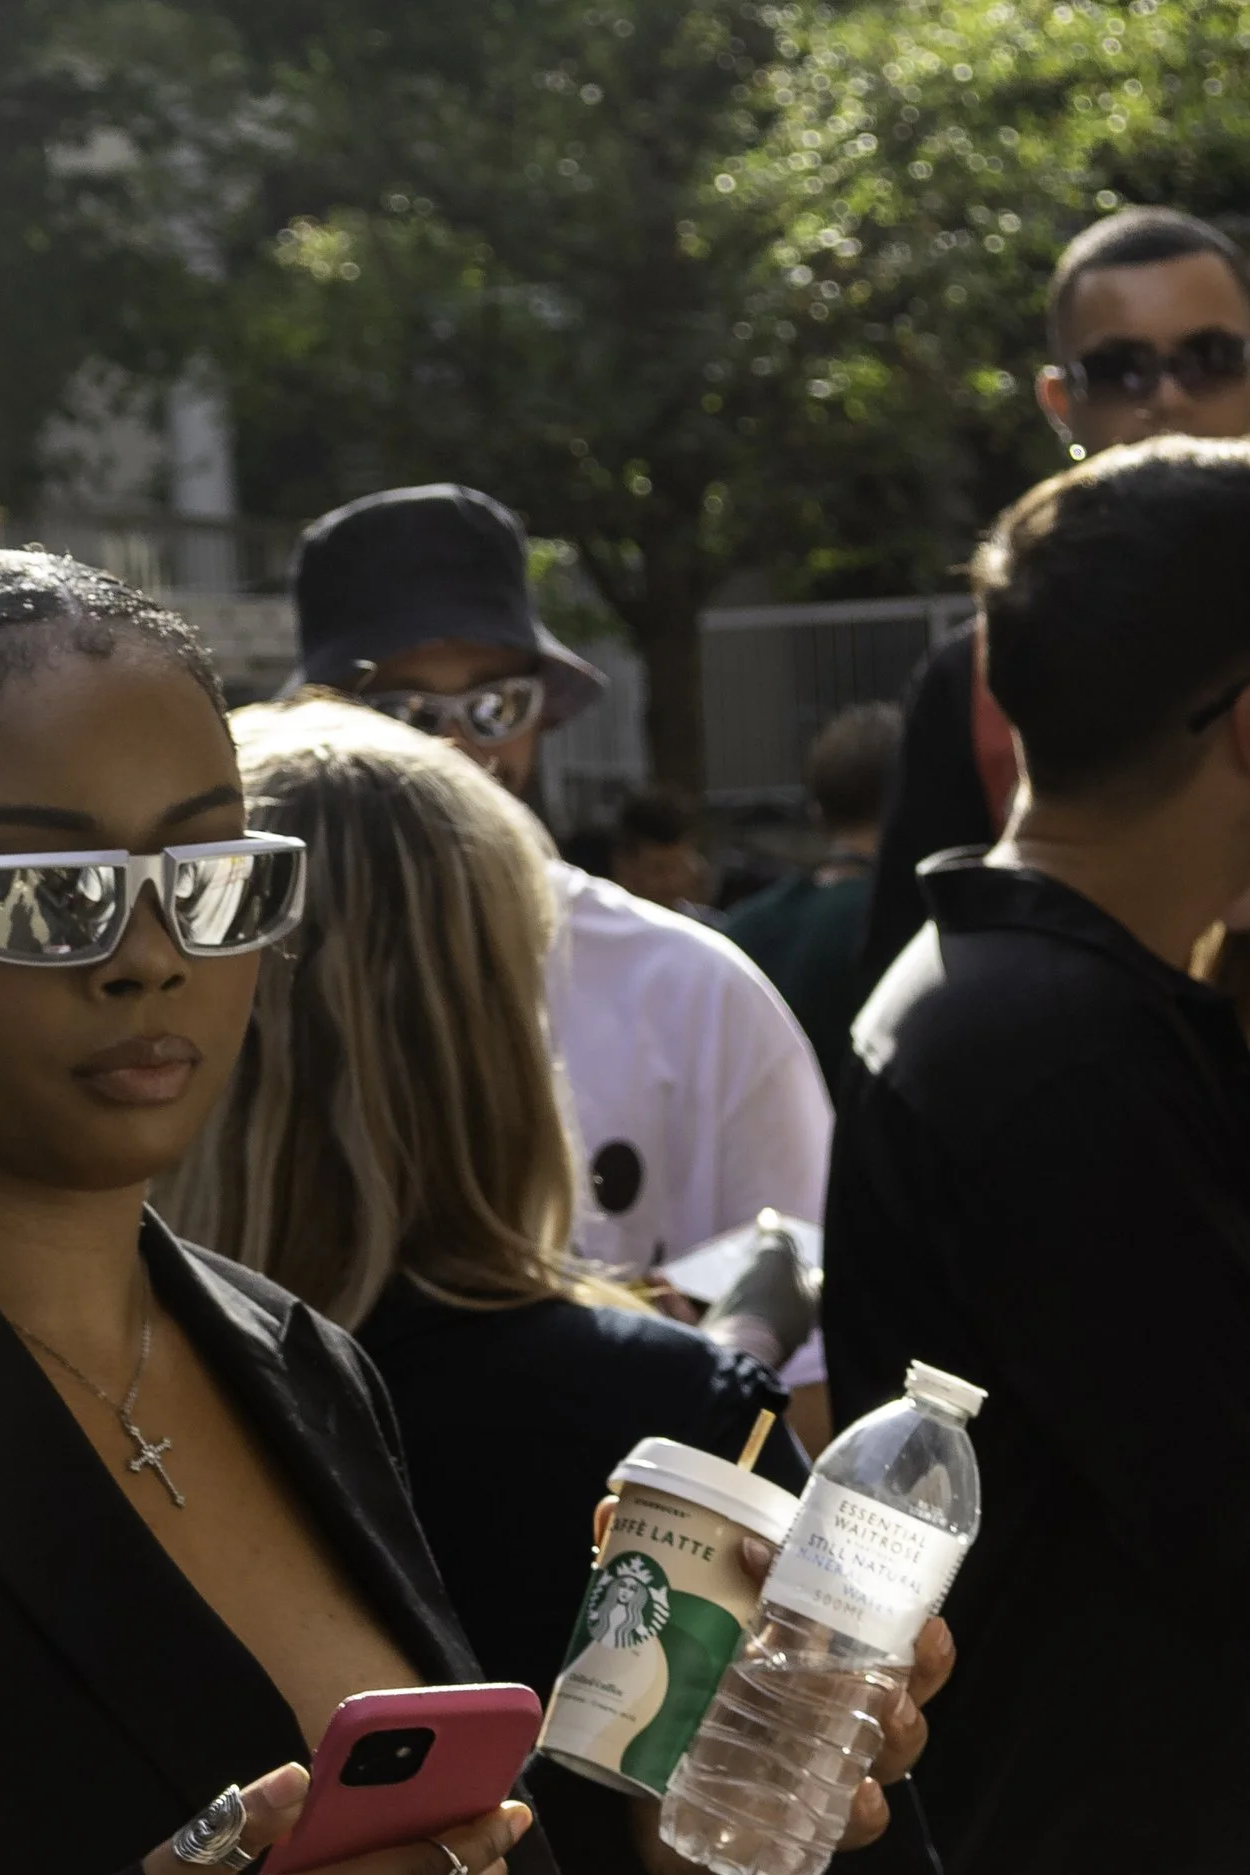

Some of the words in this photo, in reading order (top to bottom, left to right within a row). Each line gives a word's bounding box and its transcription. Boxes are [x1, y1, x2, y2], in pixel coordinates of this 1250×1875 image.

[611, 1517, 647, 1537] AFFÈ
[650, 1526, 716, 1562] LATTE
[835, 1515, 921, 1564] WAITROSE
[838, 1500, 926, 1548] ESSENTIAL
[807, 1533, 845, 1561] STILL
[853, 1554, 923, 1595] NATURAL
